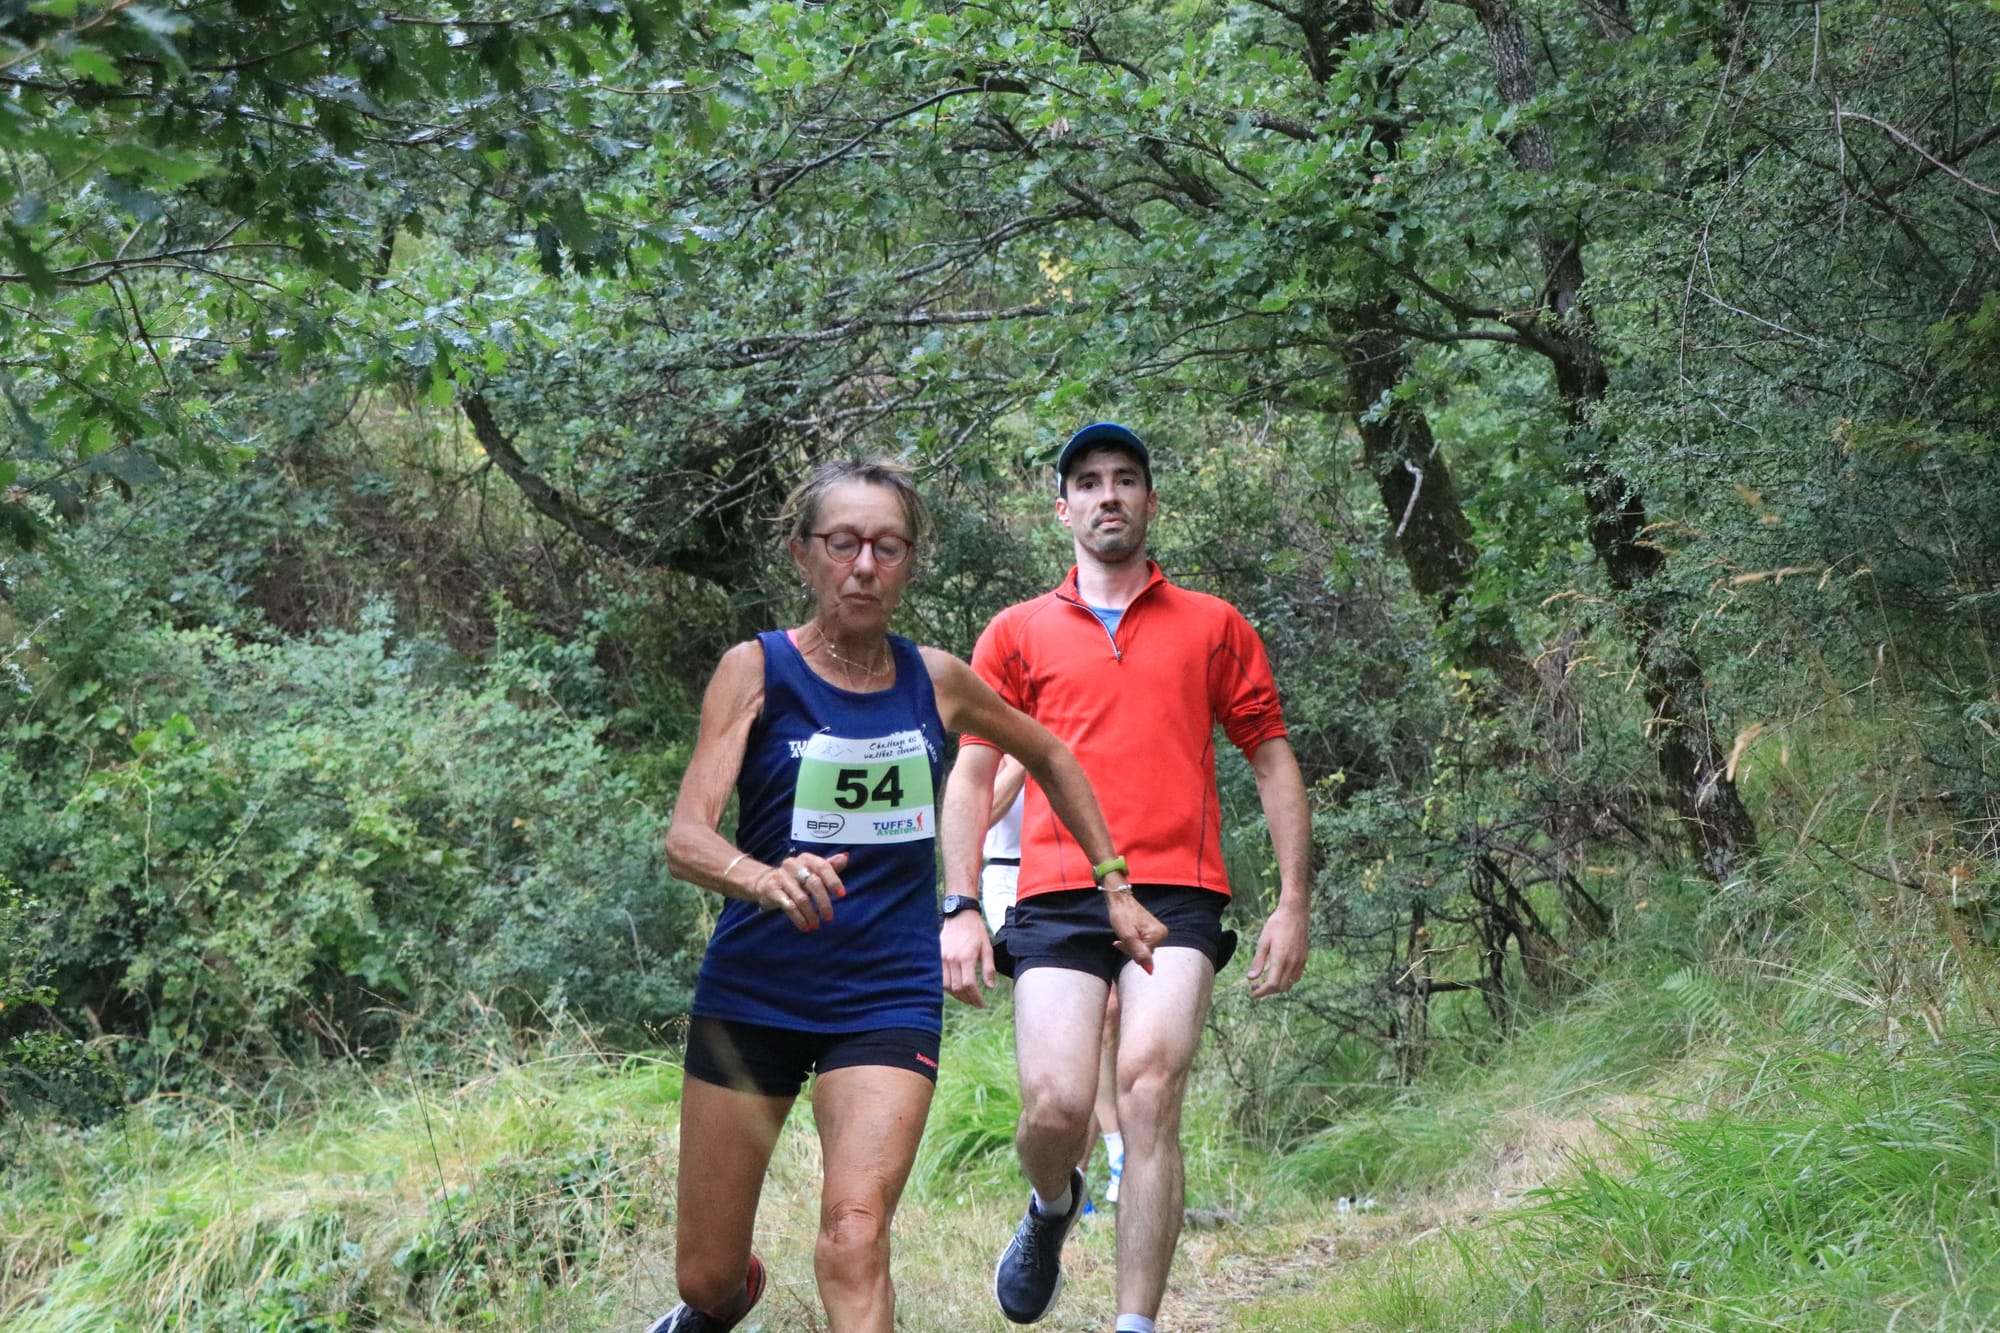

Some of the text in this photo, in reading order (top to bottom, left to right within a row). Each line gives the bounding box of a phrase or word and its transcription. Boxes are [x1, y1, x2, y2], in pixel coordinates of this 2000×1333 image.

[870, 739, 905, 751] Challenge
[834, 765, 904, 810] 54
[807, 820, 840, 830] BFP
[873, 818, 913, 831] TUFF'S
